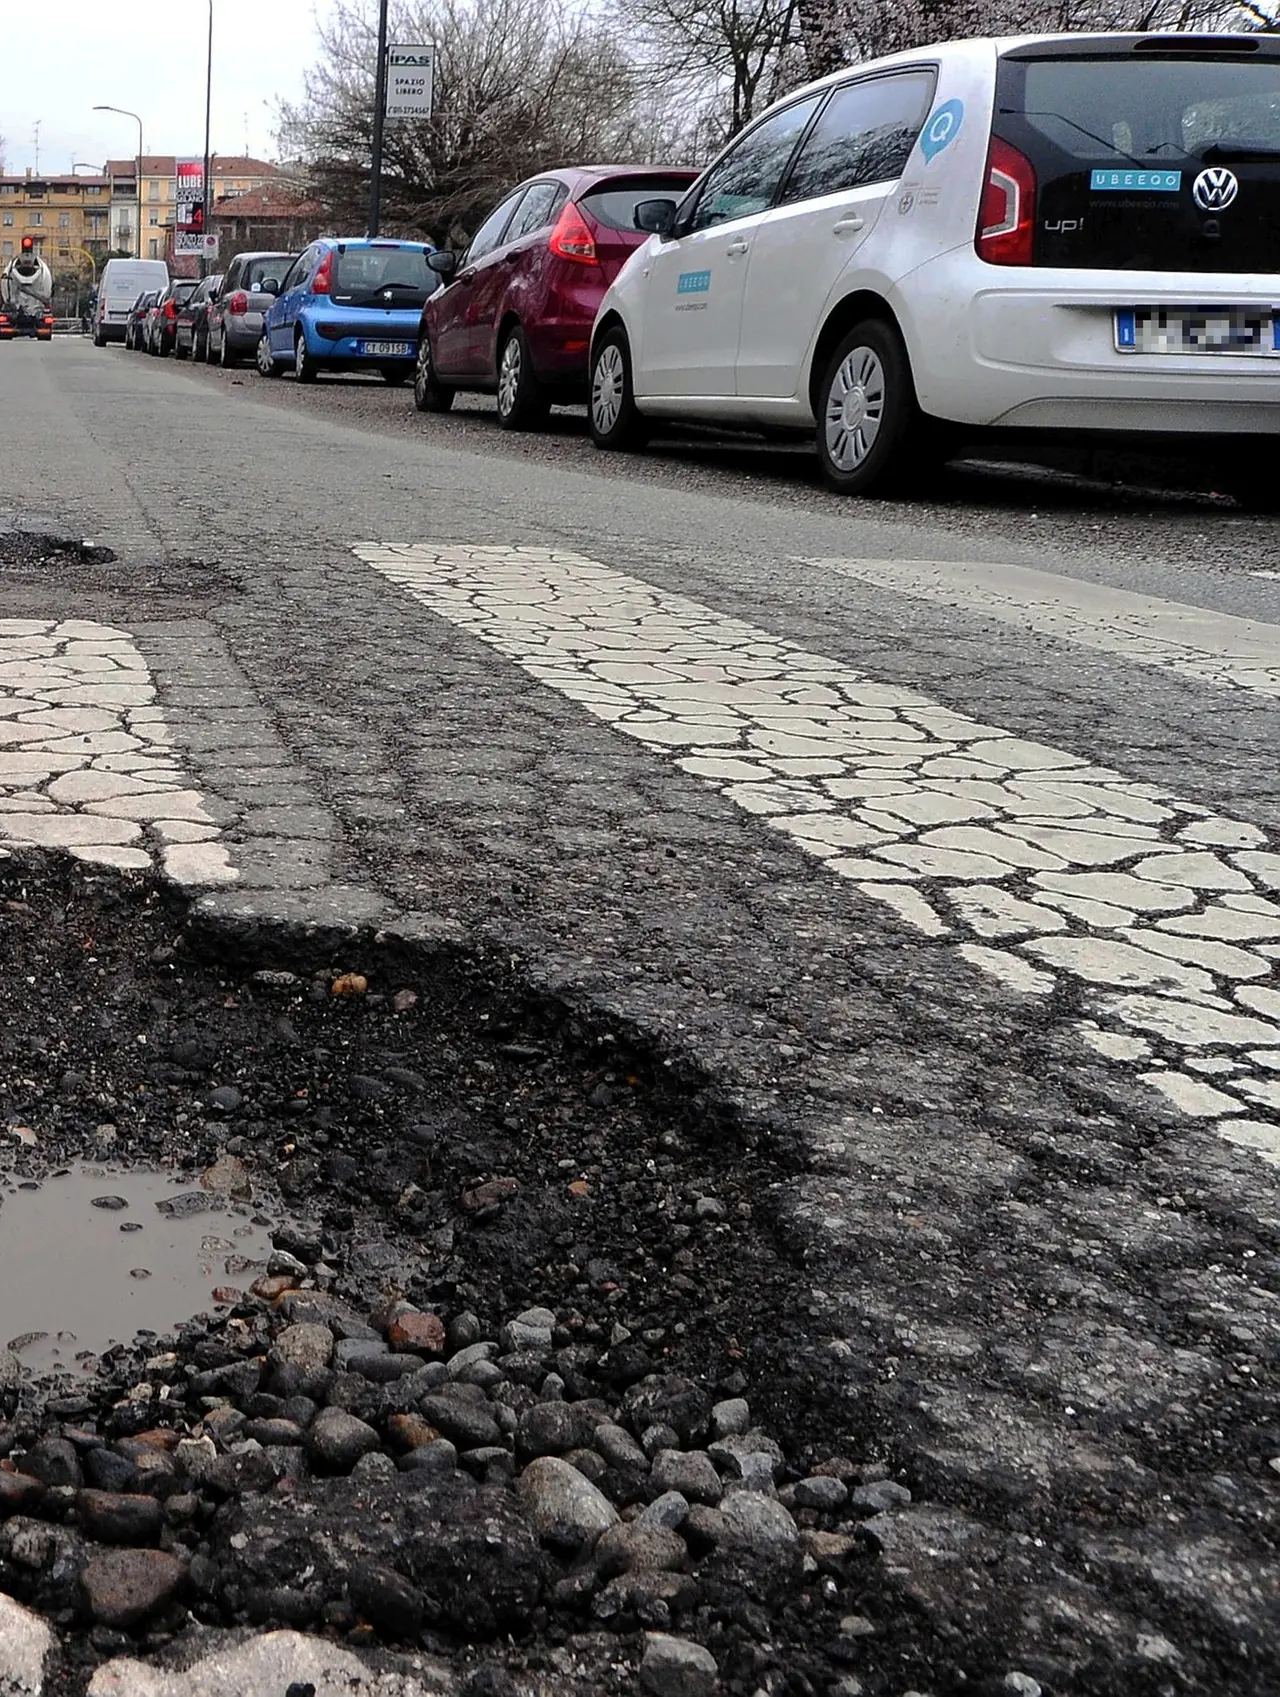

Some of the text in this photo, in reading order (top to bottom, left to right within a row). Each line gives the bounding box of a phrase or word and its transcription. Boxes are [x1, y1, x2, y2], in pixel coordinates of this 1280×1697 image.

[930, 112, 954, 142] Q
[178, 175, 202, 188] LUBE
[1096, 174, 1177, 186] UBEEQO
[1044, 218, 1084, 233] up!
